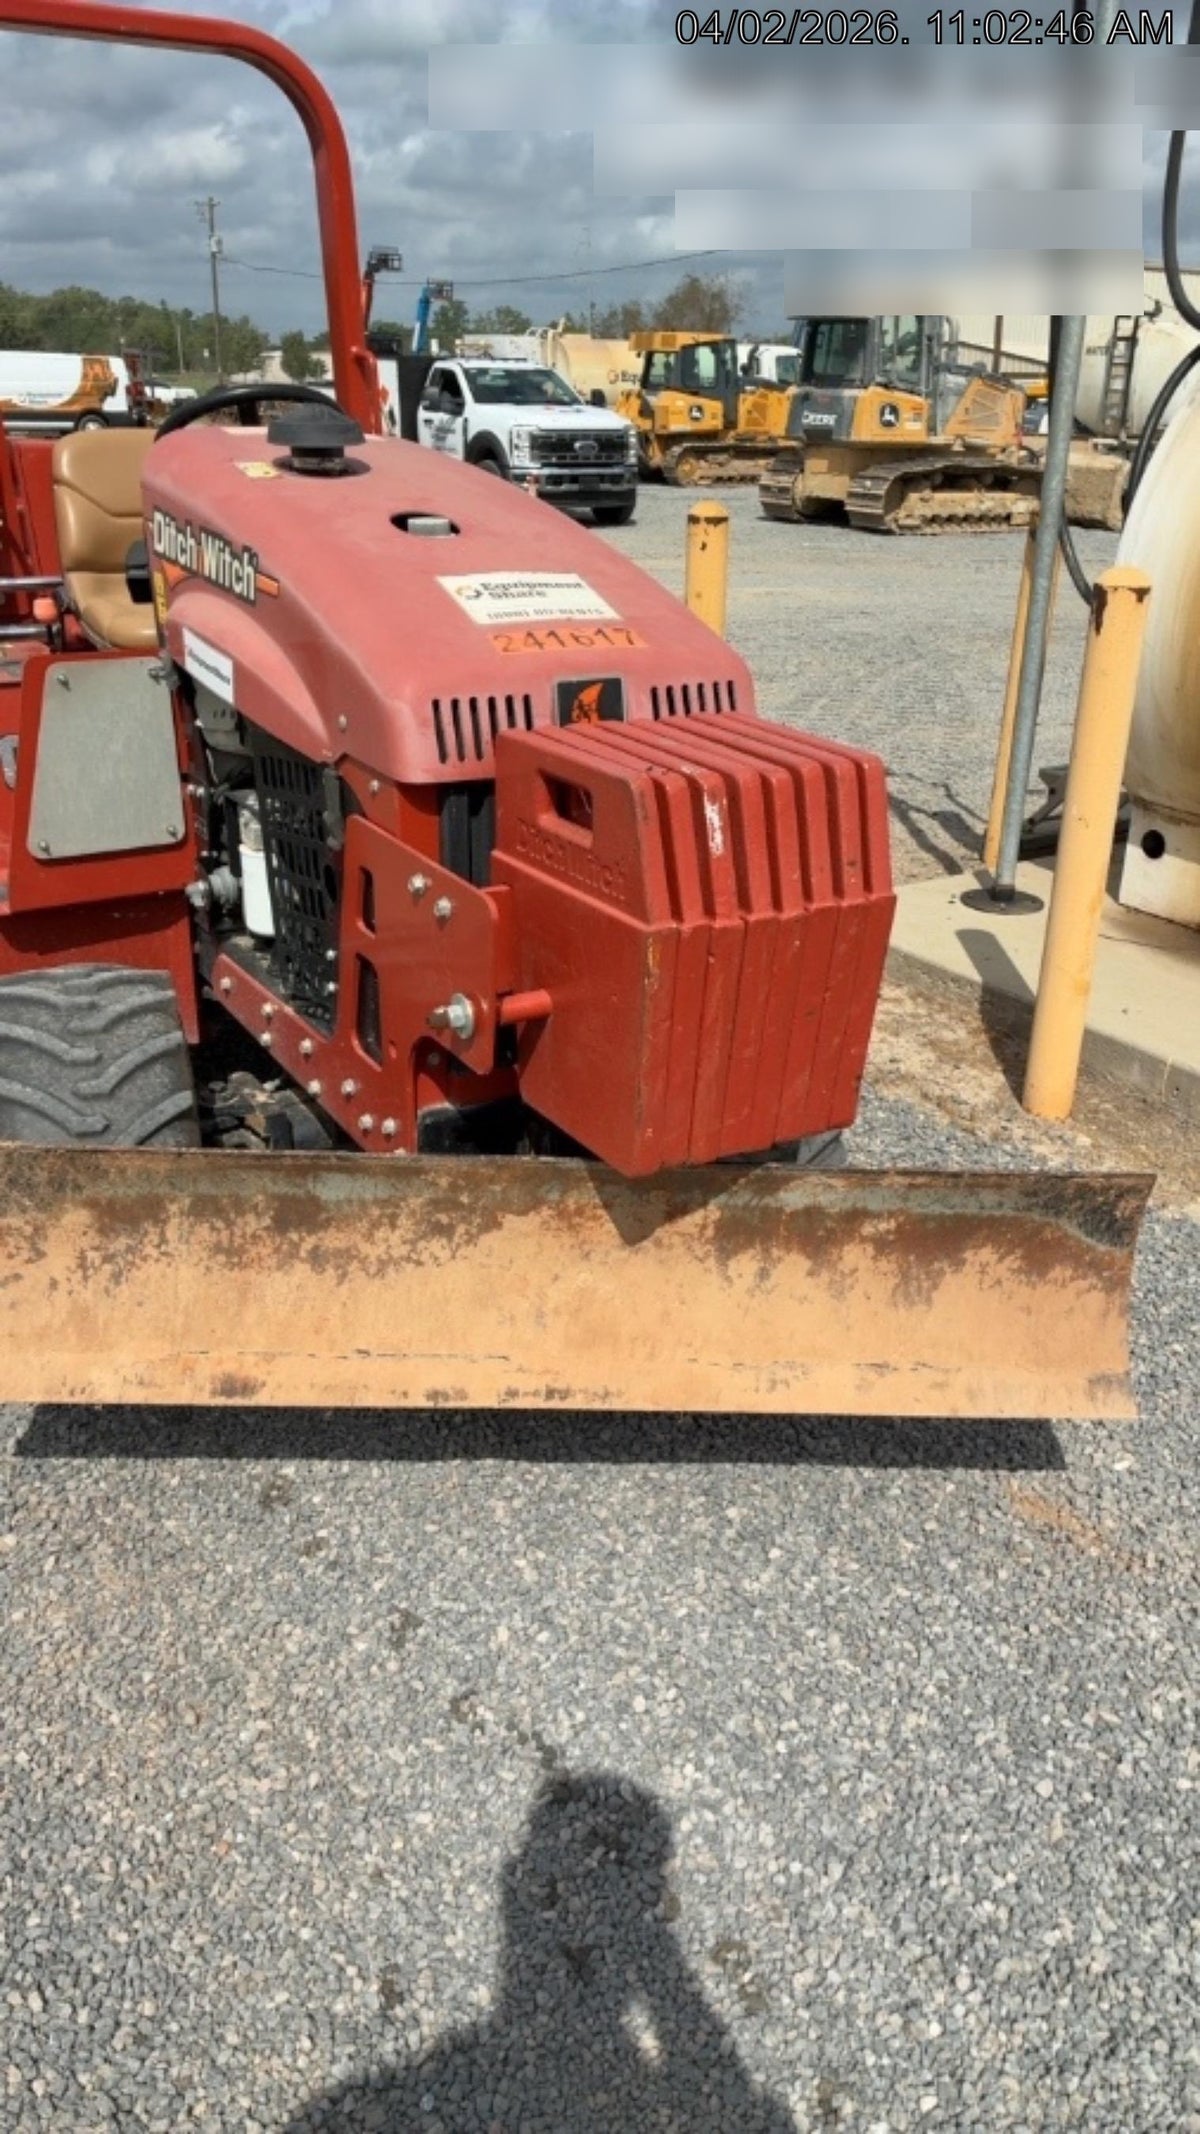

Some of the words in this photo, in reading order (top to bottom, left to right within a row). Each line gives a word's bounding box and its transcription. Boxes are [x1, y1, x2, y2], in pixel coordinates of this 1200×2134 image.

[153, 510, 198, 572] Ditch
[200, 531, 256, 601] Witch
[480, 580, 583, 592] Equipment
[493, 627, 636, 653] 241617
